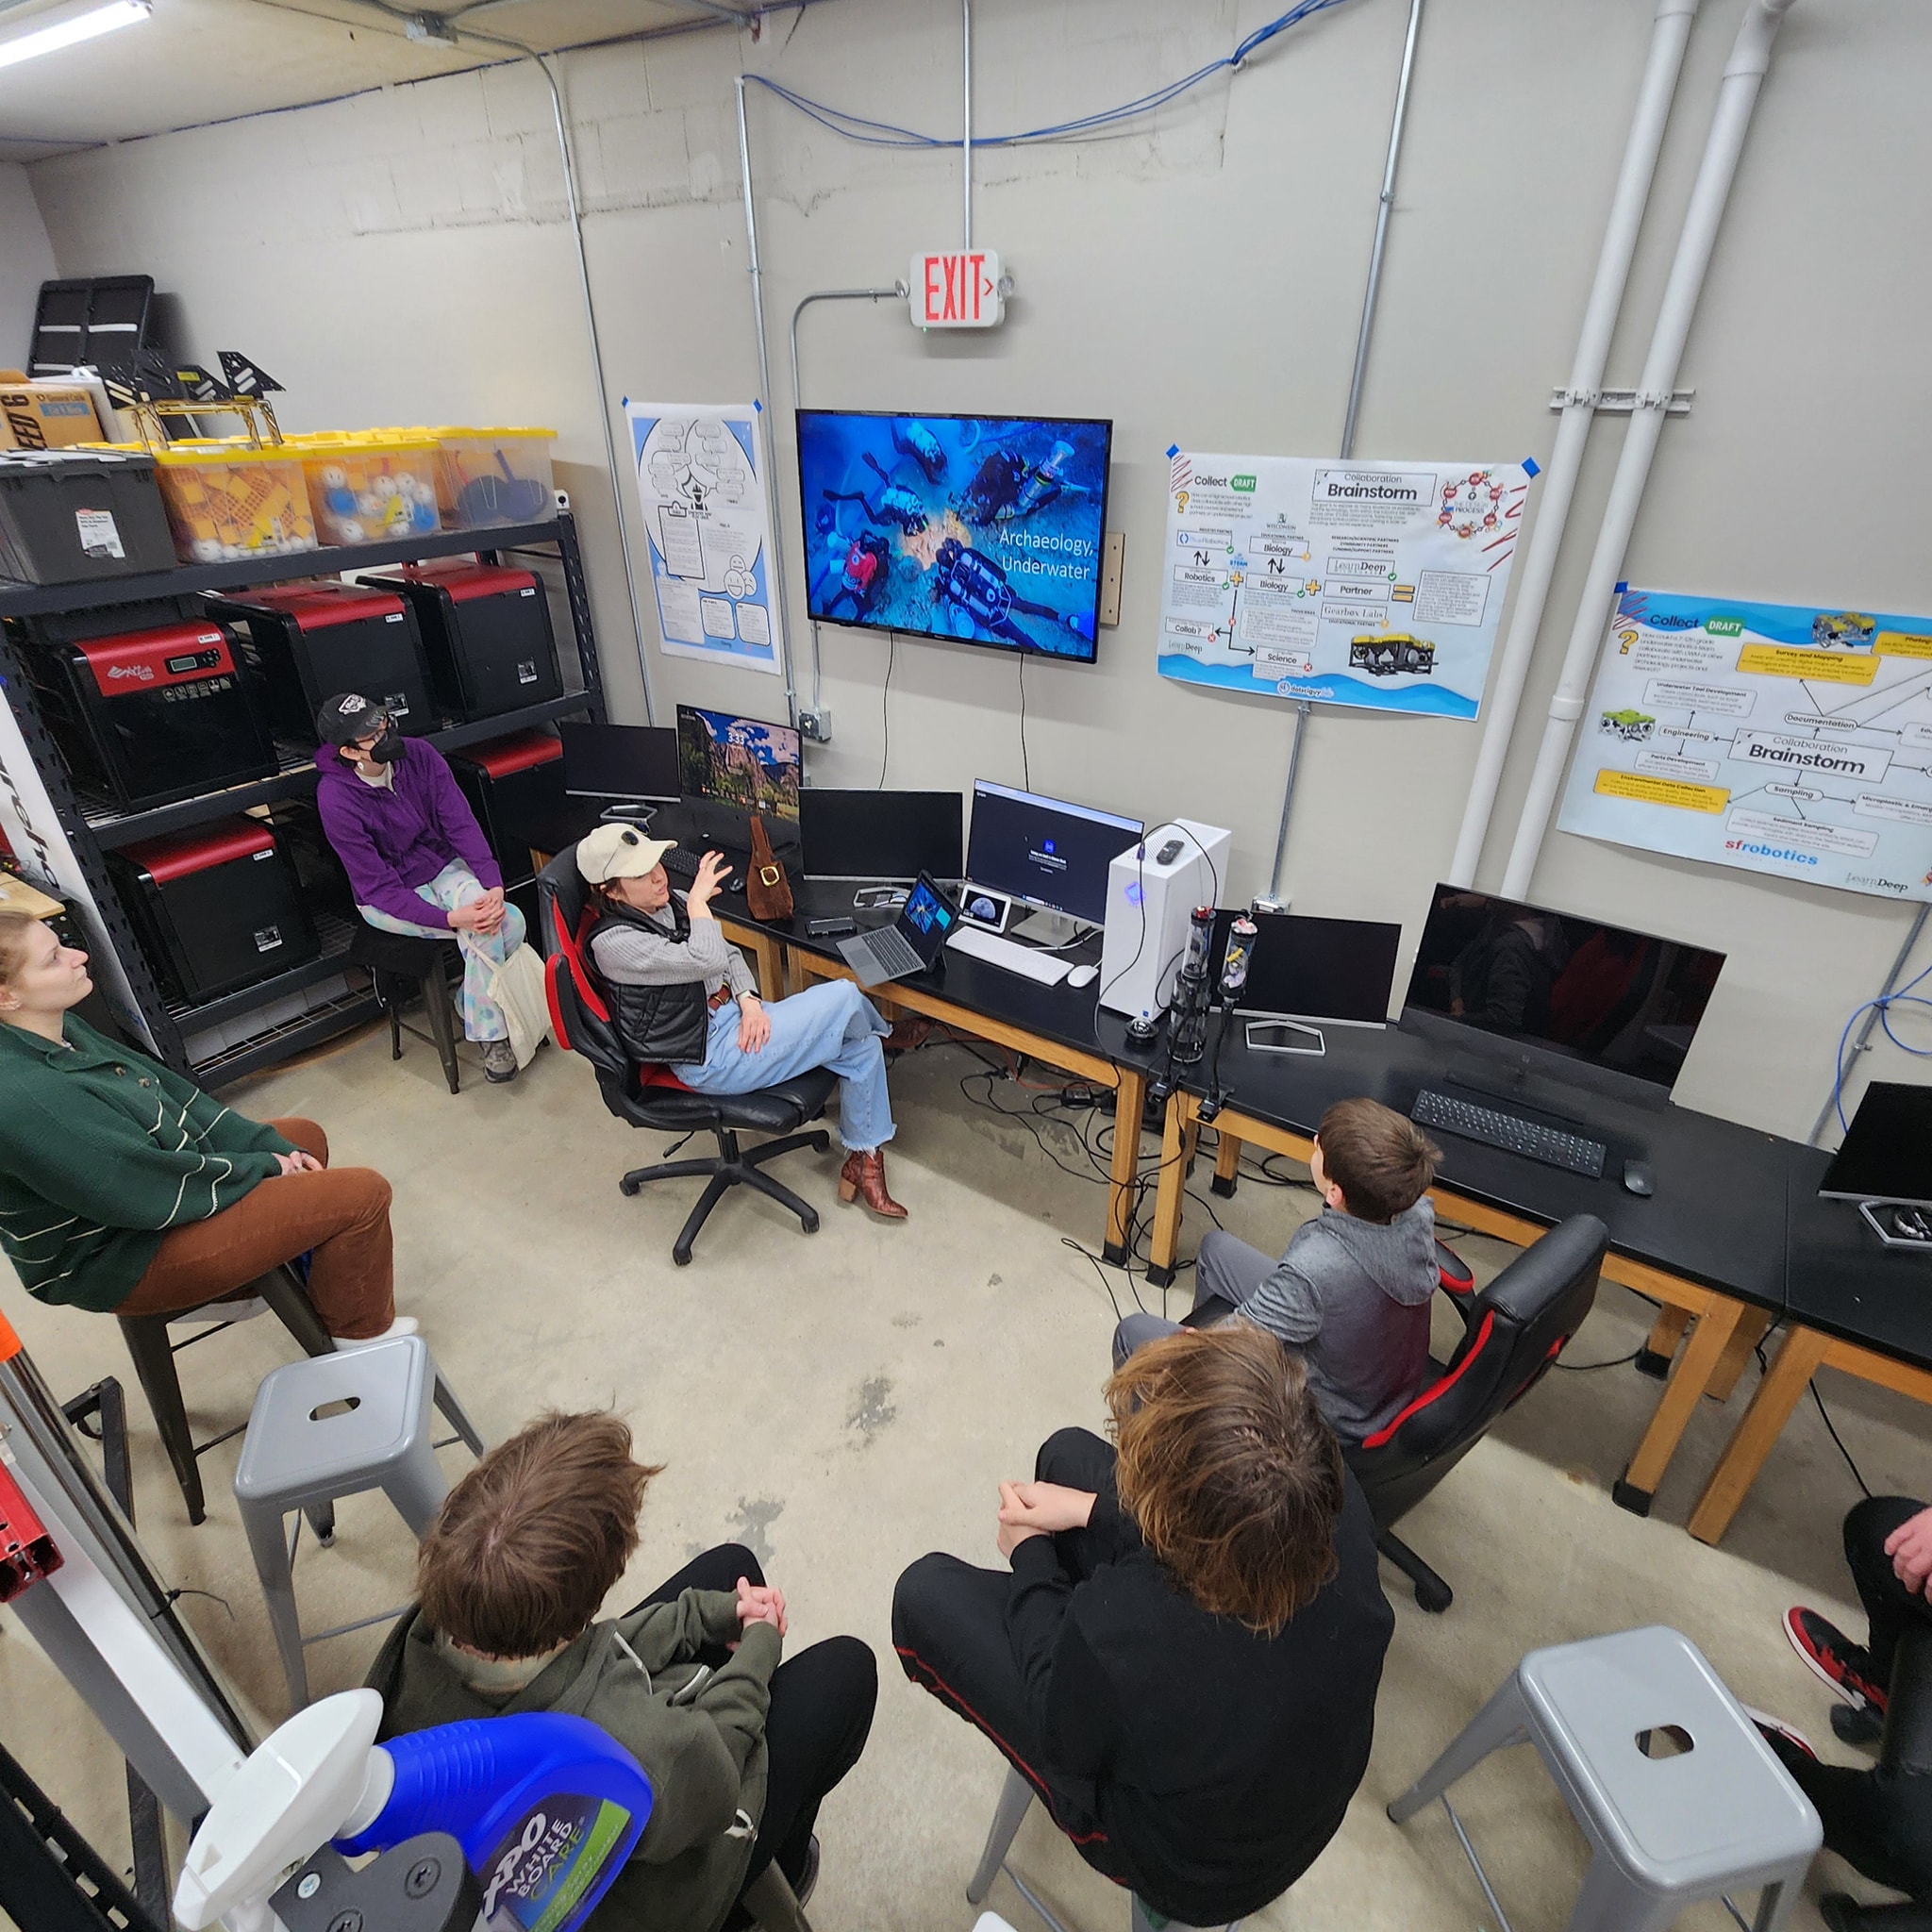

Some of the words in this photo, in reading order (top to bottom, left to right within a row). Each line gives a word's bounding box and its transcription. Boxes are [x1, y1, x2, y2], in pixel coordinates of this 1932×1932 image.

[924, 255, 985, 320] EXIT
[1194, 475, 1227, 488] Collect
[1233, 478, 1256, 489] DRAFT
[1344, 474, 1403, 484] Collaboration
[1327, 483, 1418, 501] Brainstorm
[999, 528, 1094, 556] Archaeology,
[1263, 544, 1294, 557] Biology
[1001, 556, 1091, 580] Underwater
[1334, 559, 1387, 575] LearnDeep
[1184, 572, 1216, 583] Robotics
[1259, 579, 1289, 592] Biology
[1340, 585, 1373, 595] Partner
[1324, 606, 1359, 617] Gearbox
[1174, 625, 1197, 634] Collab
[1650, 614, 1700, 628] Collect
[1708, 620, 1742, 633] DRAFT
[1267, 653, 1298, 664] Science
[1787, 714, 1856, 729] Documentation
[727, 732, 745, 745] 3:33
[1663, 727, 1710, 741] Engineering
[1773, 736, 1848, 755] Collaboration
[1748, 743, 1866, 775] Brainstorm
[1774, 786, 1815, 800] Sampling
[1724, 839, 1819, 866] sfrobotics
[1845, 872, 1908, 893] LearnDeep
[506, 1818, 565, 1893] WHITE
[518, 1822, 573, 1898] BOARD
[530, 1825, 585, 1901] CARE
